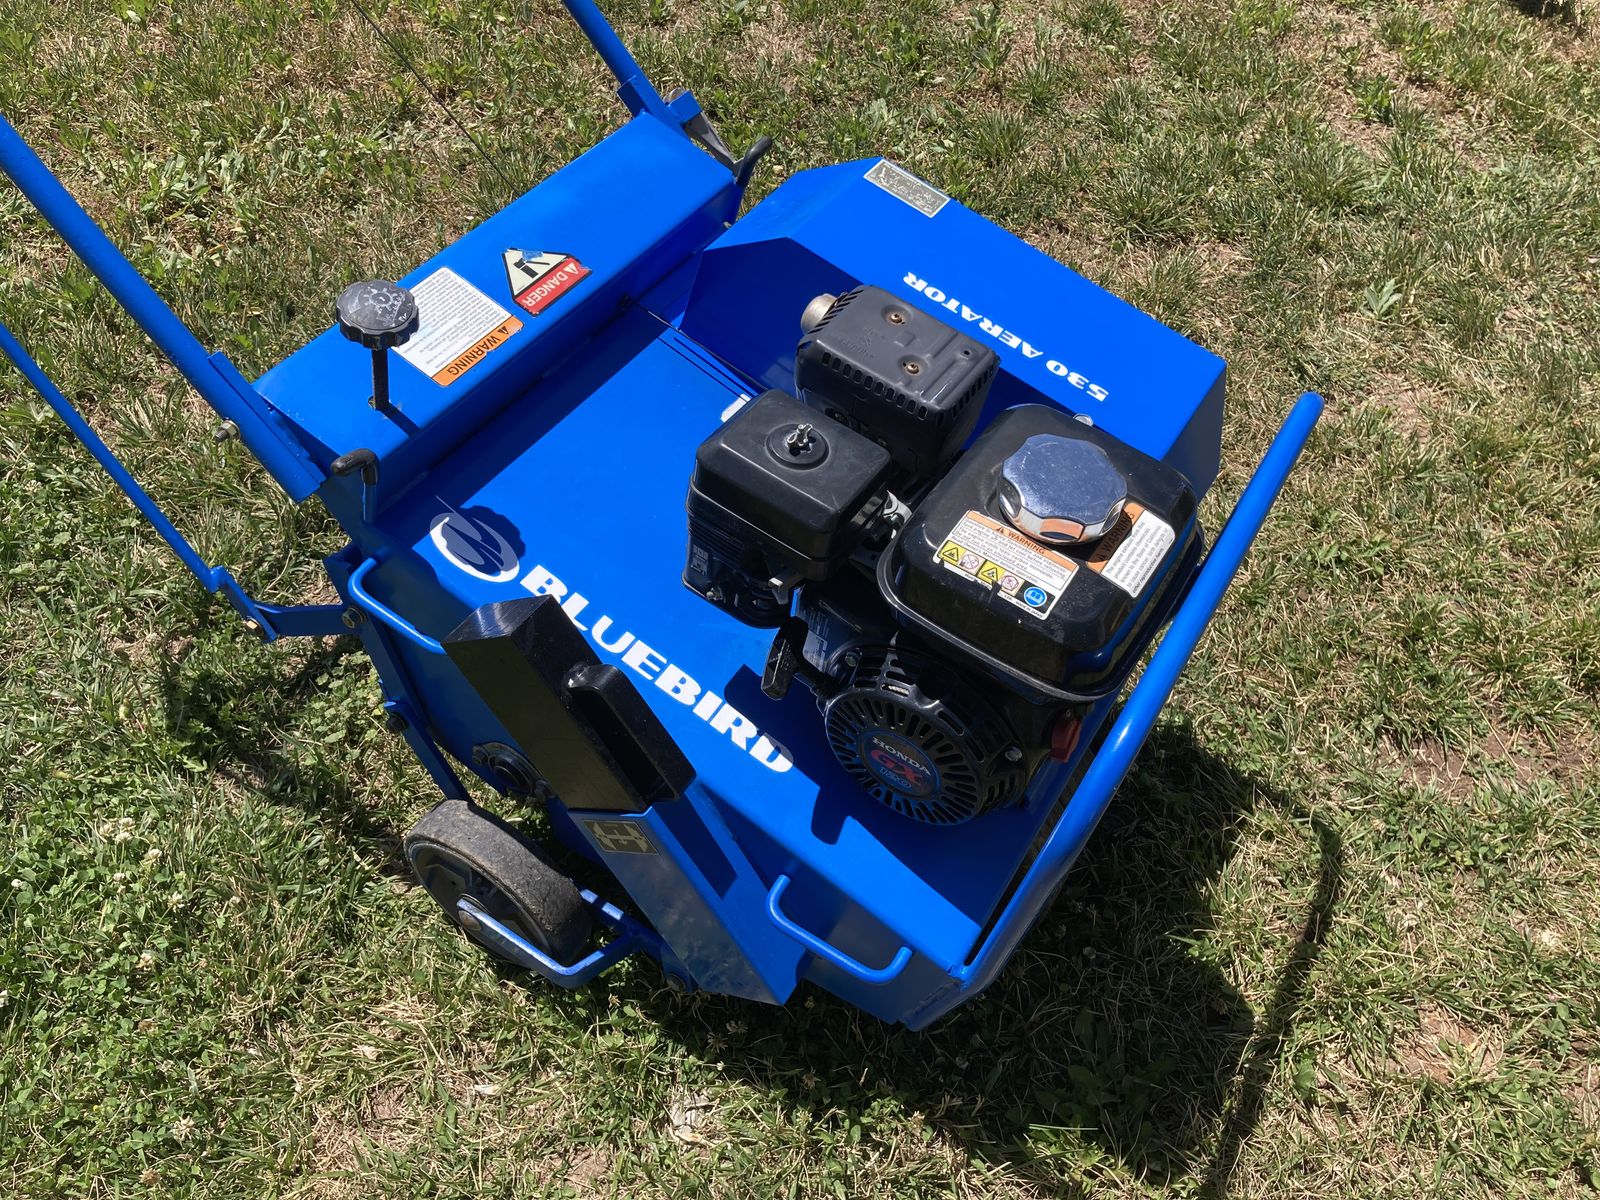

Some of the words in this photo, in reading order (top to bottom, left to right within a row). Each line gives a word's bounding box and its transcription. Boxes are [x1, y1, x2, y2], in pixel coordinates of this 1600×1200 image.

[522, 273, 569, 307] DANGER
[903, 272, 1043, 359] AERATOR
[447, 335, 501, 376] WARNING
[1046, 360, 1109, 402] 530
[1007, 531, 1045, 554] WARNING
[1102, 512, 1135, 552] WARNING
[520, 564, 793, 772] BLUEBIRD
[872, 749, 924, 787] GX
[873, 736, 931, 777] HONDA
